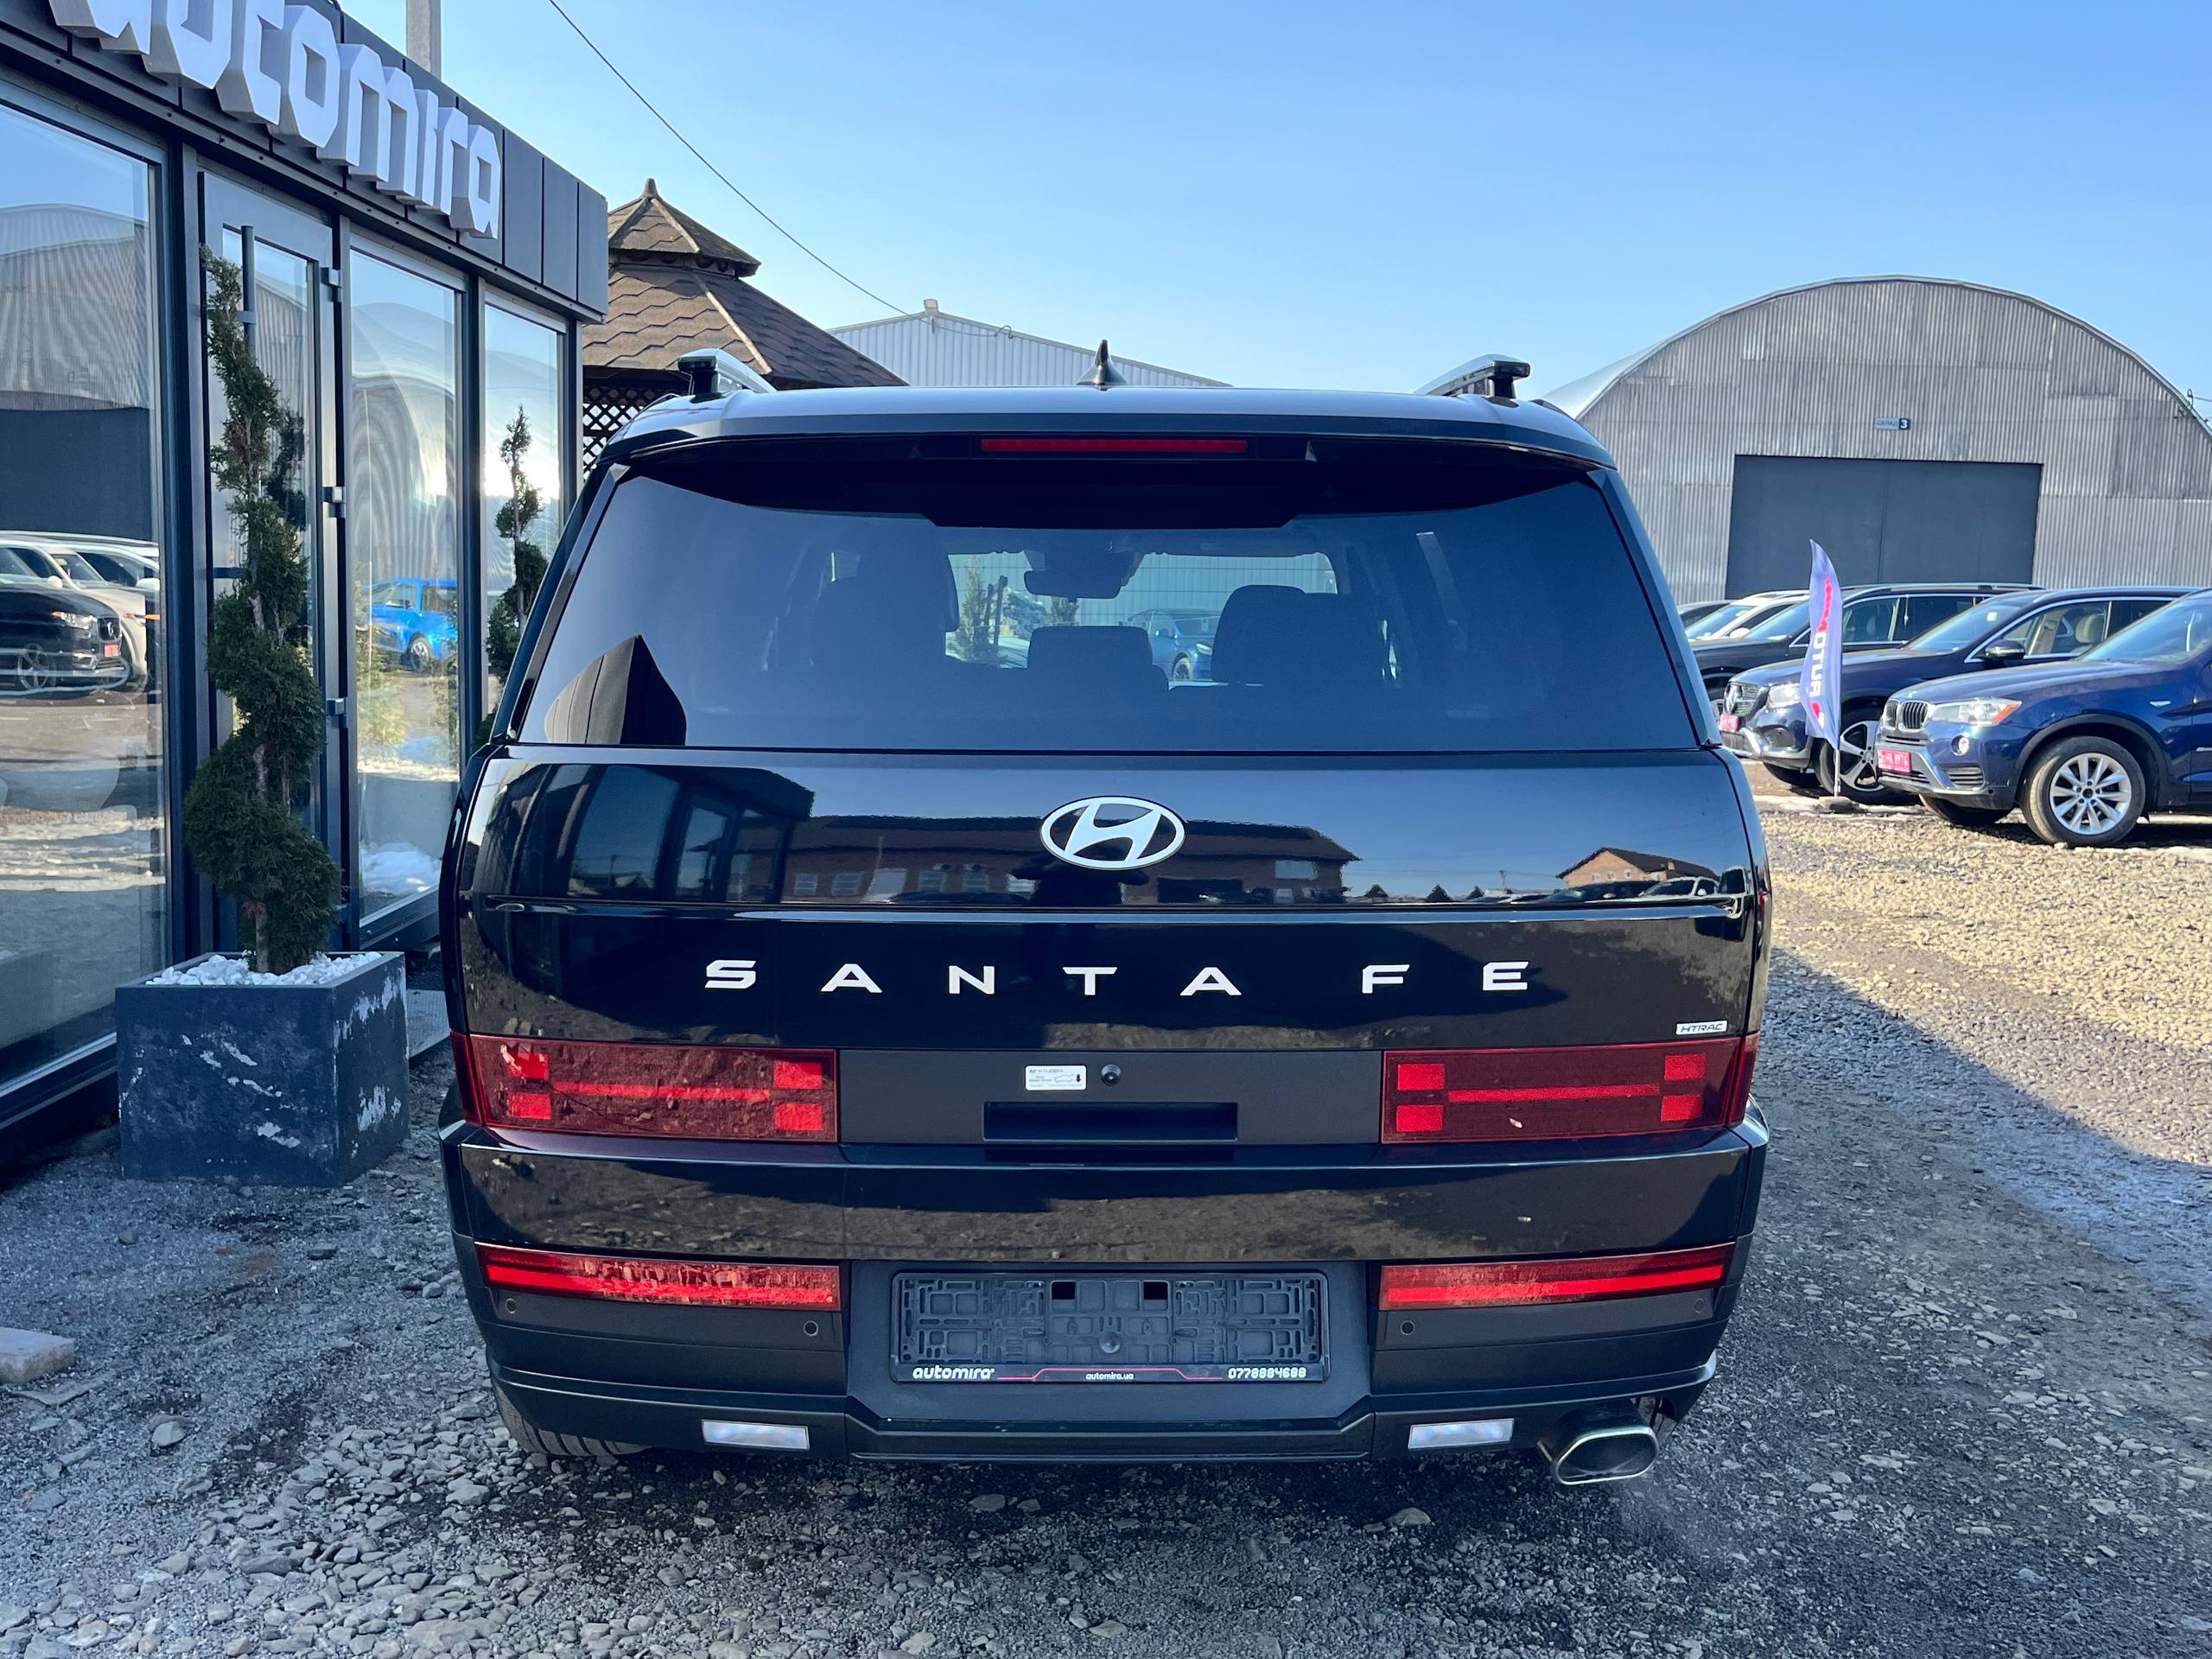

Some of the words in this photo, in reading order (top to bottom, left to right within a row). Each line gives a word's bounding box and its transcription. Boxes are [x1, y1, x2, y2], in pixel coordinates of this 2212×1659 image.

[1900, 419, 1908, 429] 3
[703, 958, 1243, 997] SANTA
[1362, 961, 1530, 995] FE
[1681, 1023, 1724, 1033] HTRAC
[912, 1365, 995, 1379] automira
[1085, 1371, 1134, 1380] automira.ua
